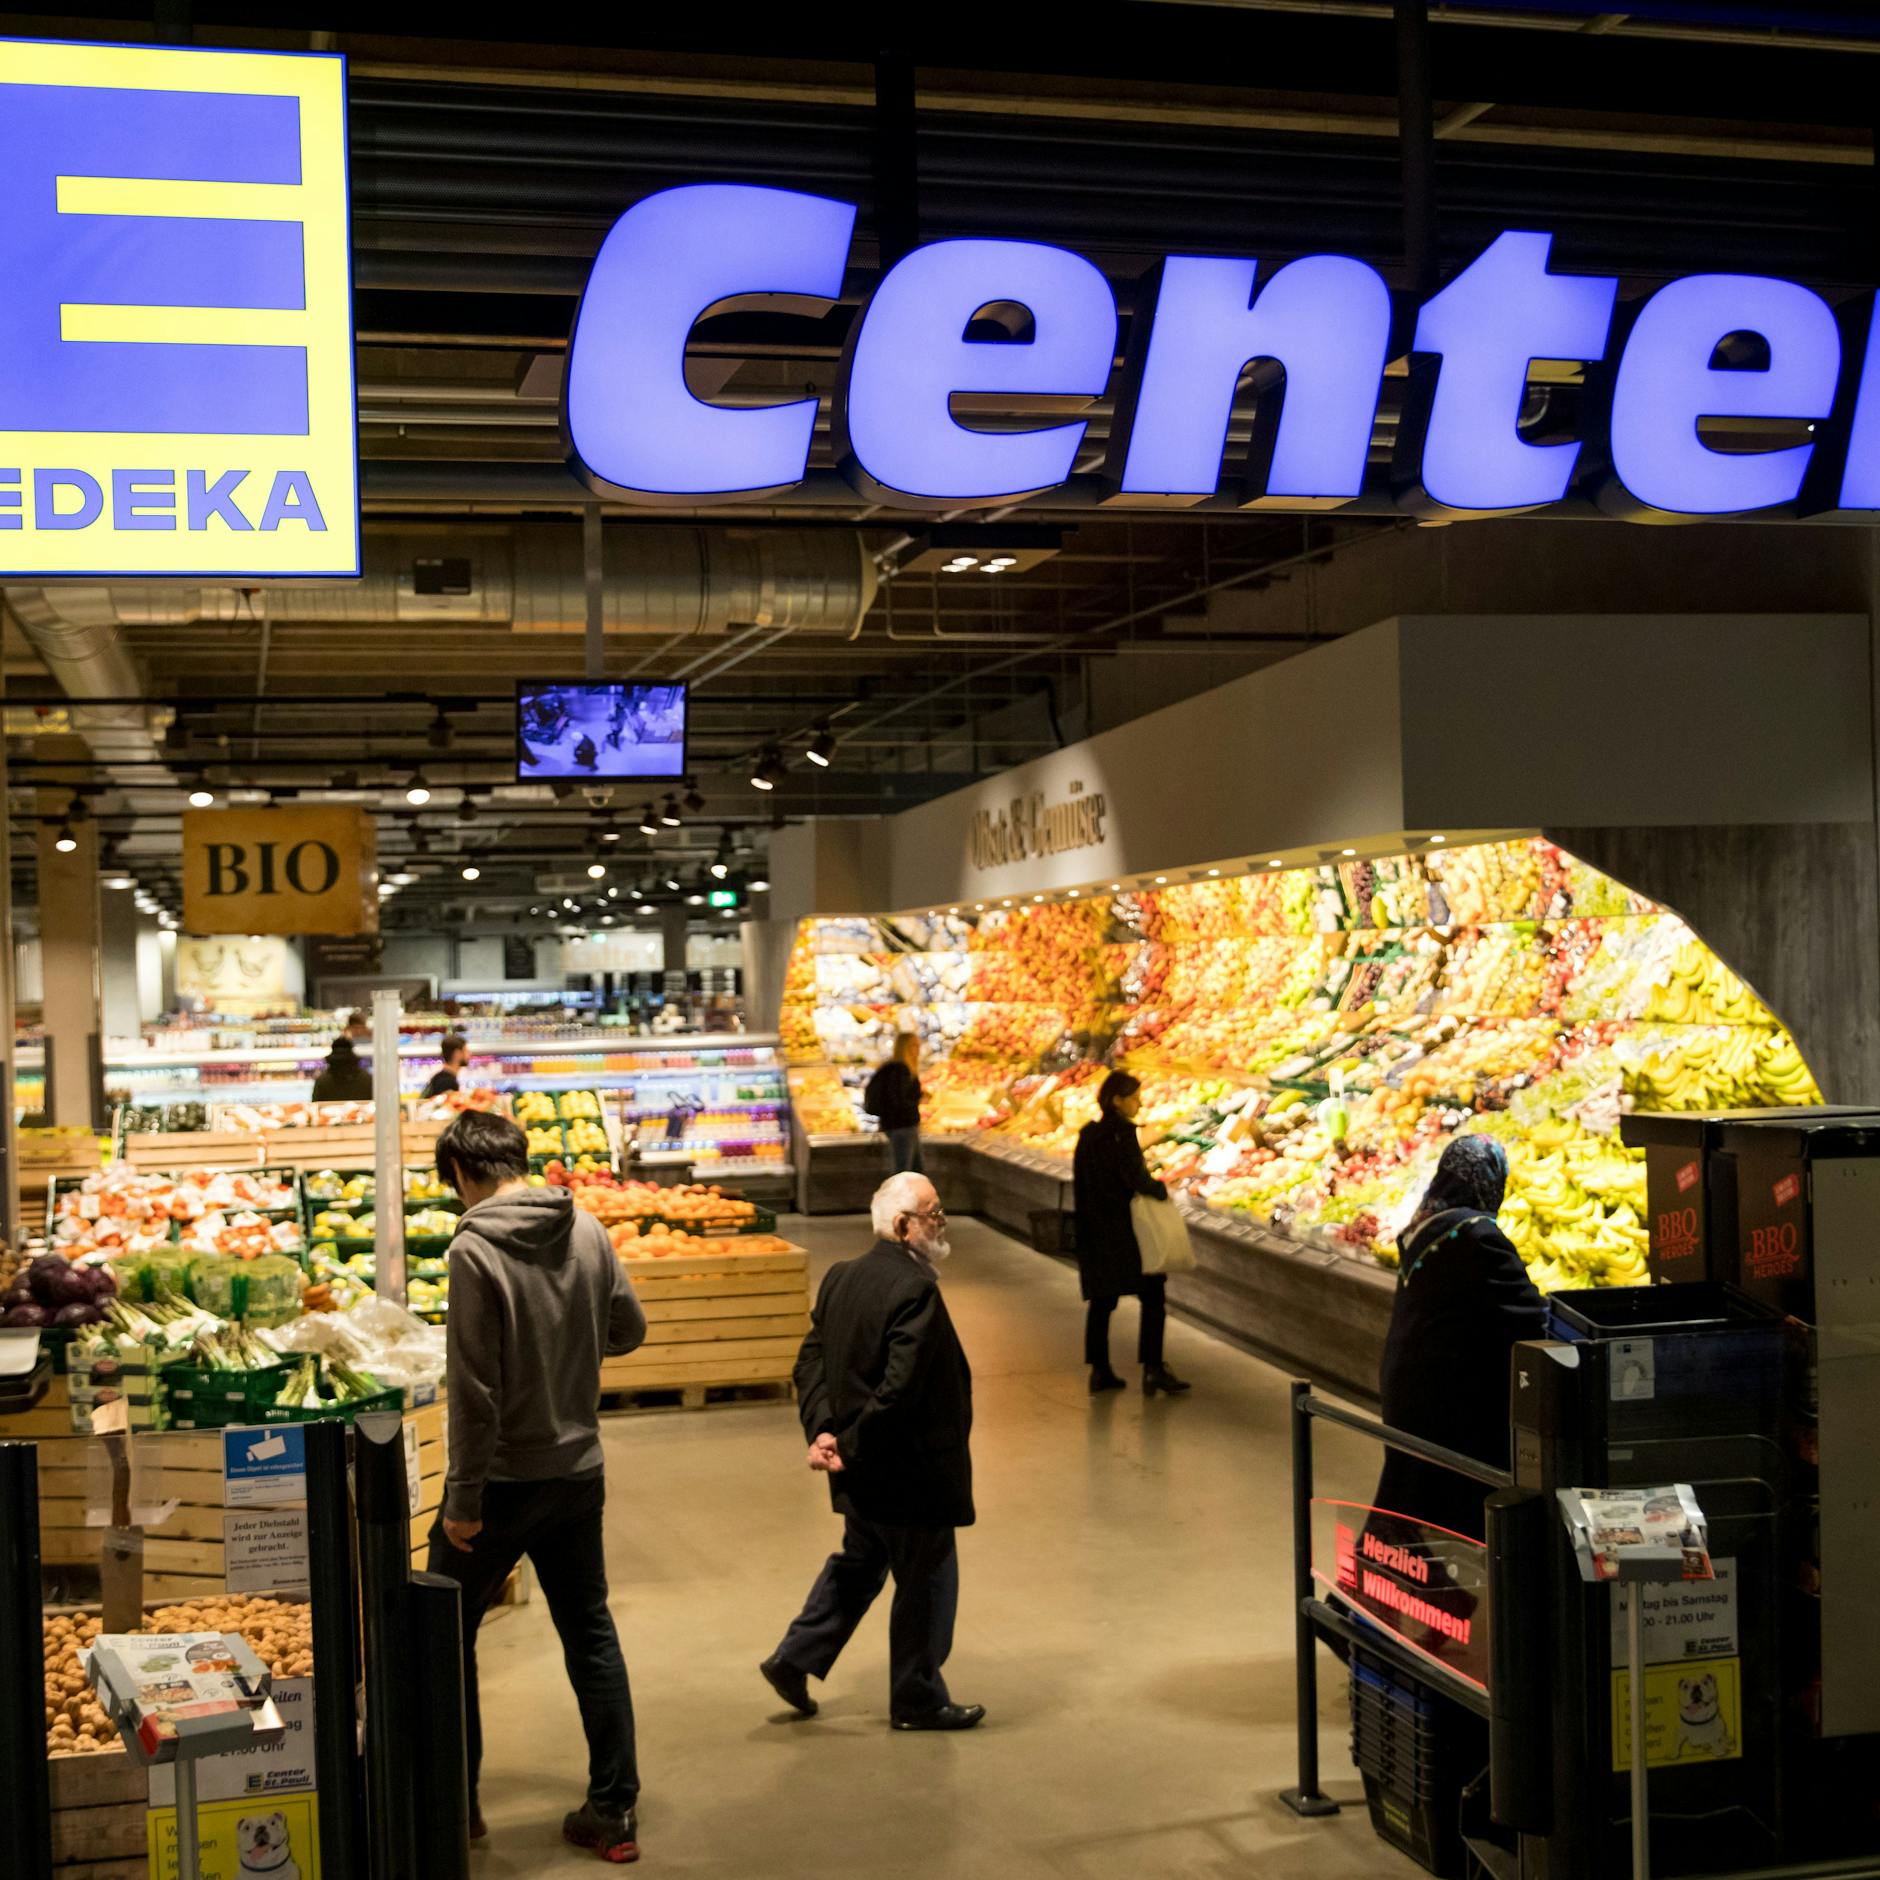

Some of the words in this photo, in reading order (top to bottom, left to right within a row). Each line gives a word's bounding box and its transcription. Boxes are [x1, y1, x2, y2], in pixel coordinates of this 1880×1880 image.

[567, 183, 1880, 513] Cente
[203, 839, 341, 896] BIO
[1657, 1207, 1698, 1241] BBQ
[1751, 1222, 1798, 1259] BBQ
[1753, 1261, 1794, 1279] HEROES
[231, 1533, 251, 1542] wird
[270, 1529, 304, 1539] Anzeige
[233, 1521, 258, 1532] Jeder
[260, 1517, 300, 1529] Diebstahl
[1362, 1531, 1430, 1585] Herzlich
[1362, 1569, 1473, 1646] Willkommen!
[1619, 1600, 1660, 1611] Mtag
[1662, 1597, 1679, 1608] bis
[1681, 1593, 1729, 1606] Samstag
[1665, 1613, 1694, 1626] 21.00
[1696, 1610, 1715, 1621] Uhr
[266, 1768, 307, 1778] Center
